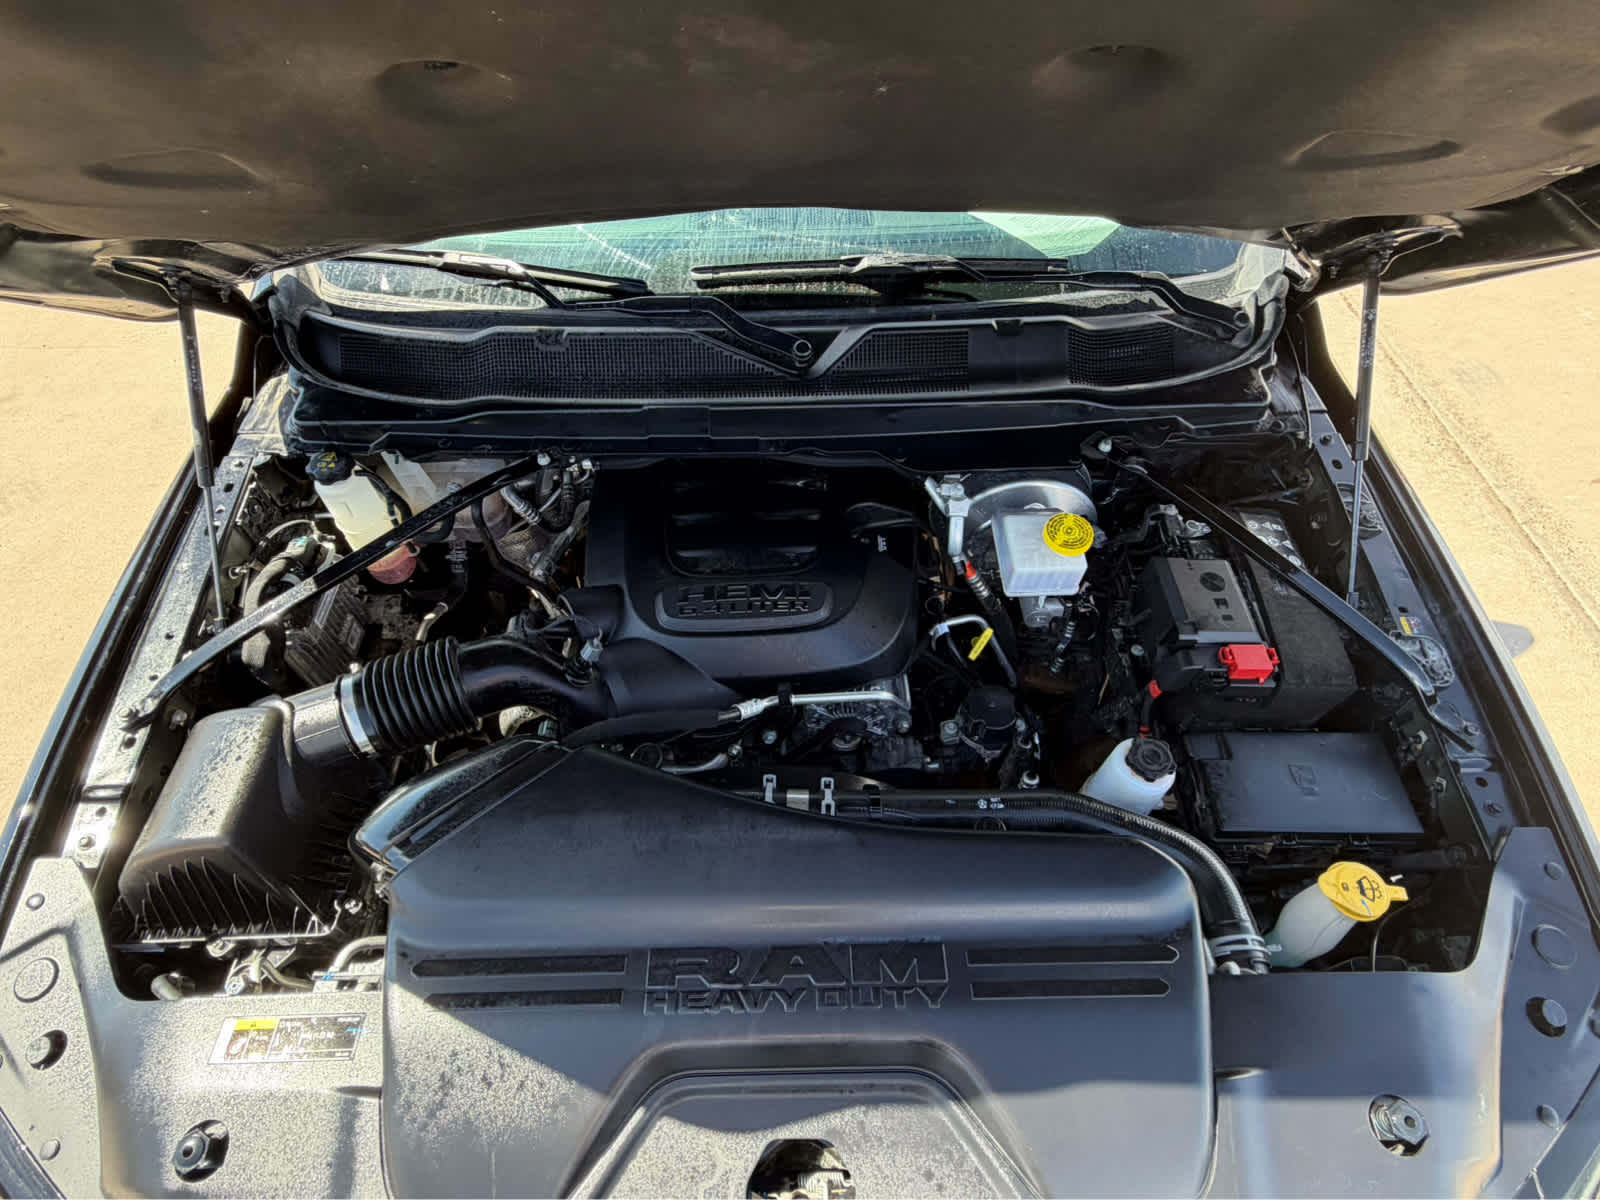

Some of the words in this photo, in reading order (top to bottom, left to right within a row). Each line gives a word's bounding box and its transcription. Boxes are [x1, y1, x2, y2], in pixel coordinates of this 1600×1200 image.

[645, 944, 949, 989] RAM
[643, 987, 807, 1016] HEAVY
[815, 985, 949, 1010] DUTY
